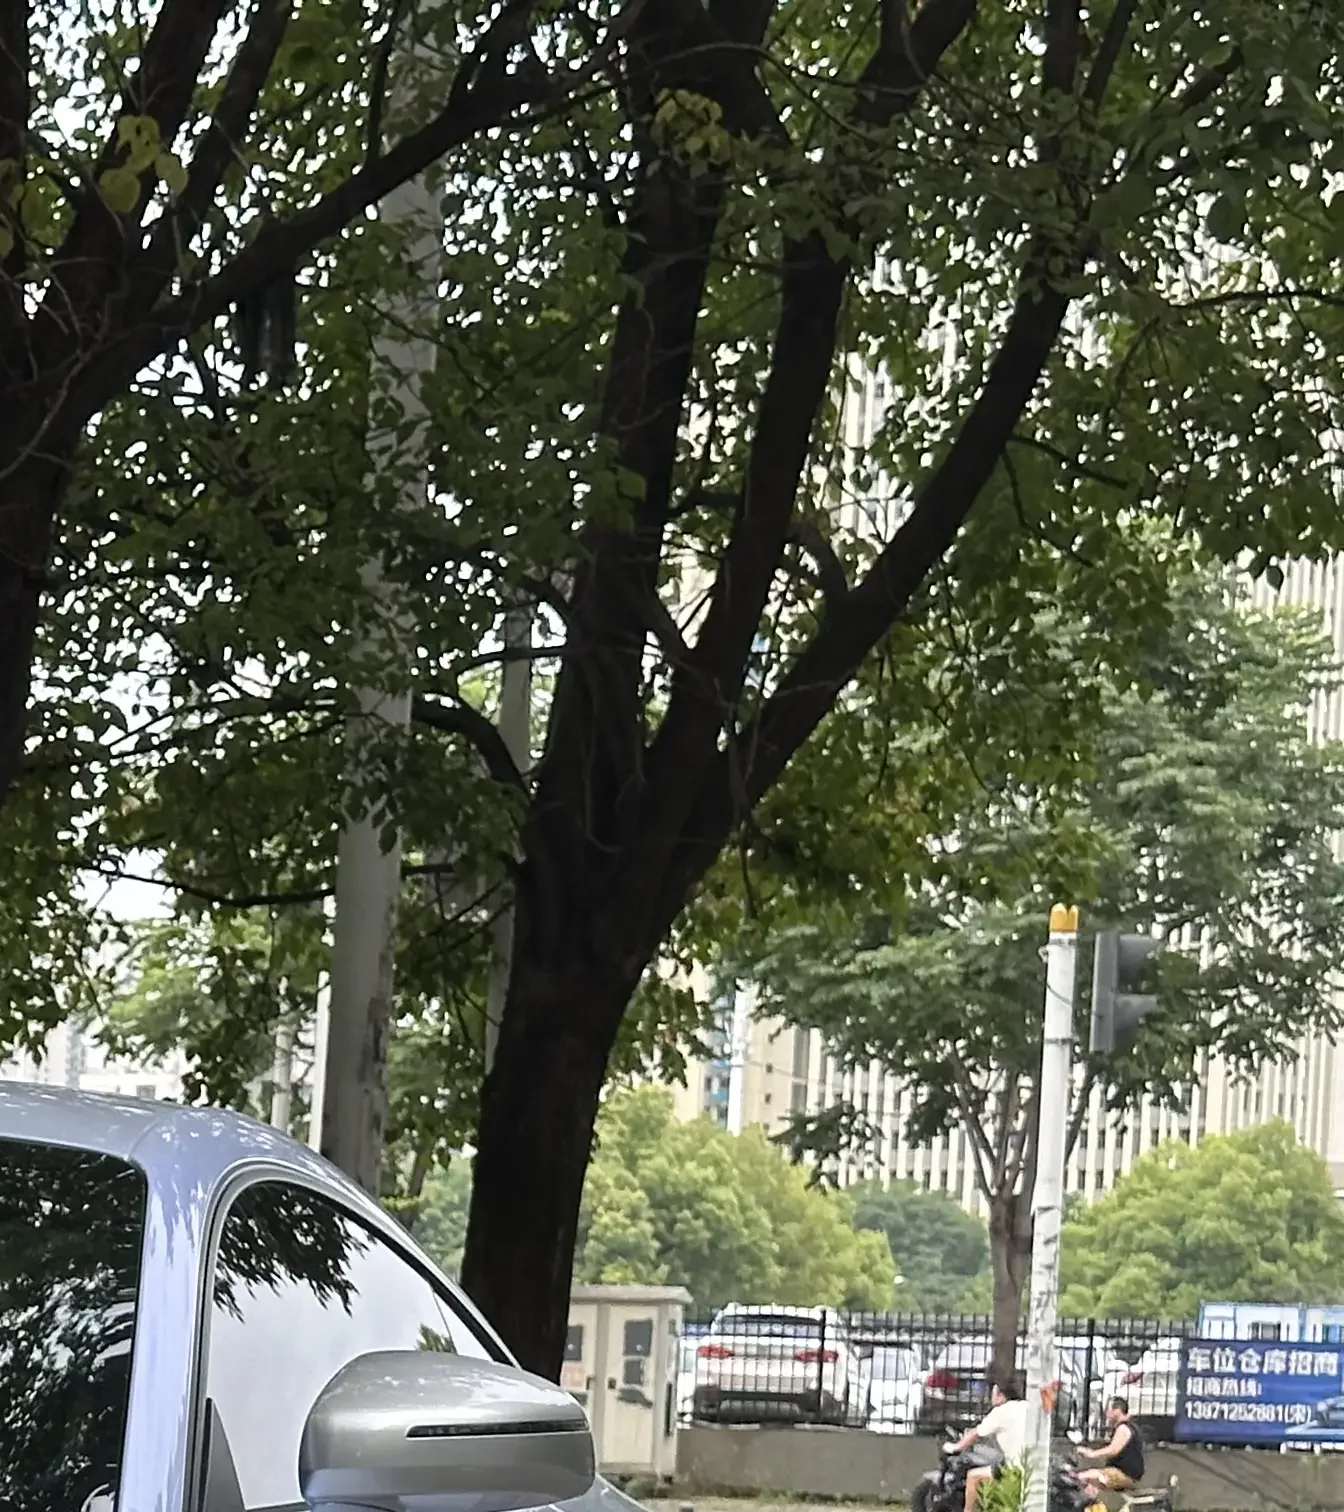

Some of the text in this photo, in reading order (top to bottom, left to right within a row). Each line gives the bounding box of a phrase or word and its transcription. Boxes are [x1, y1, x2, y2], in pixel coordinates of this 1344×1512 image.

[1187, 1347, 1339, 1376] 车位仓库招商
